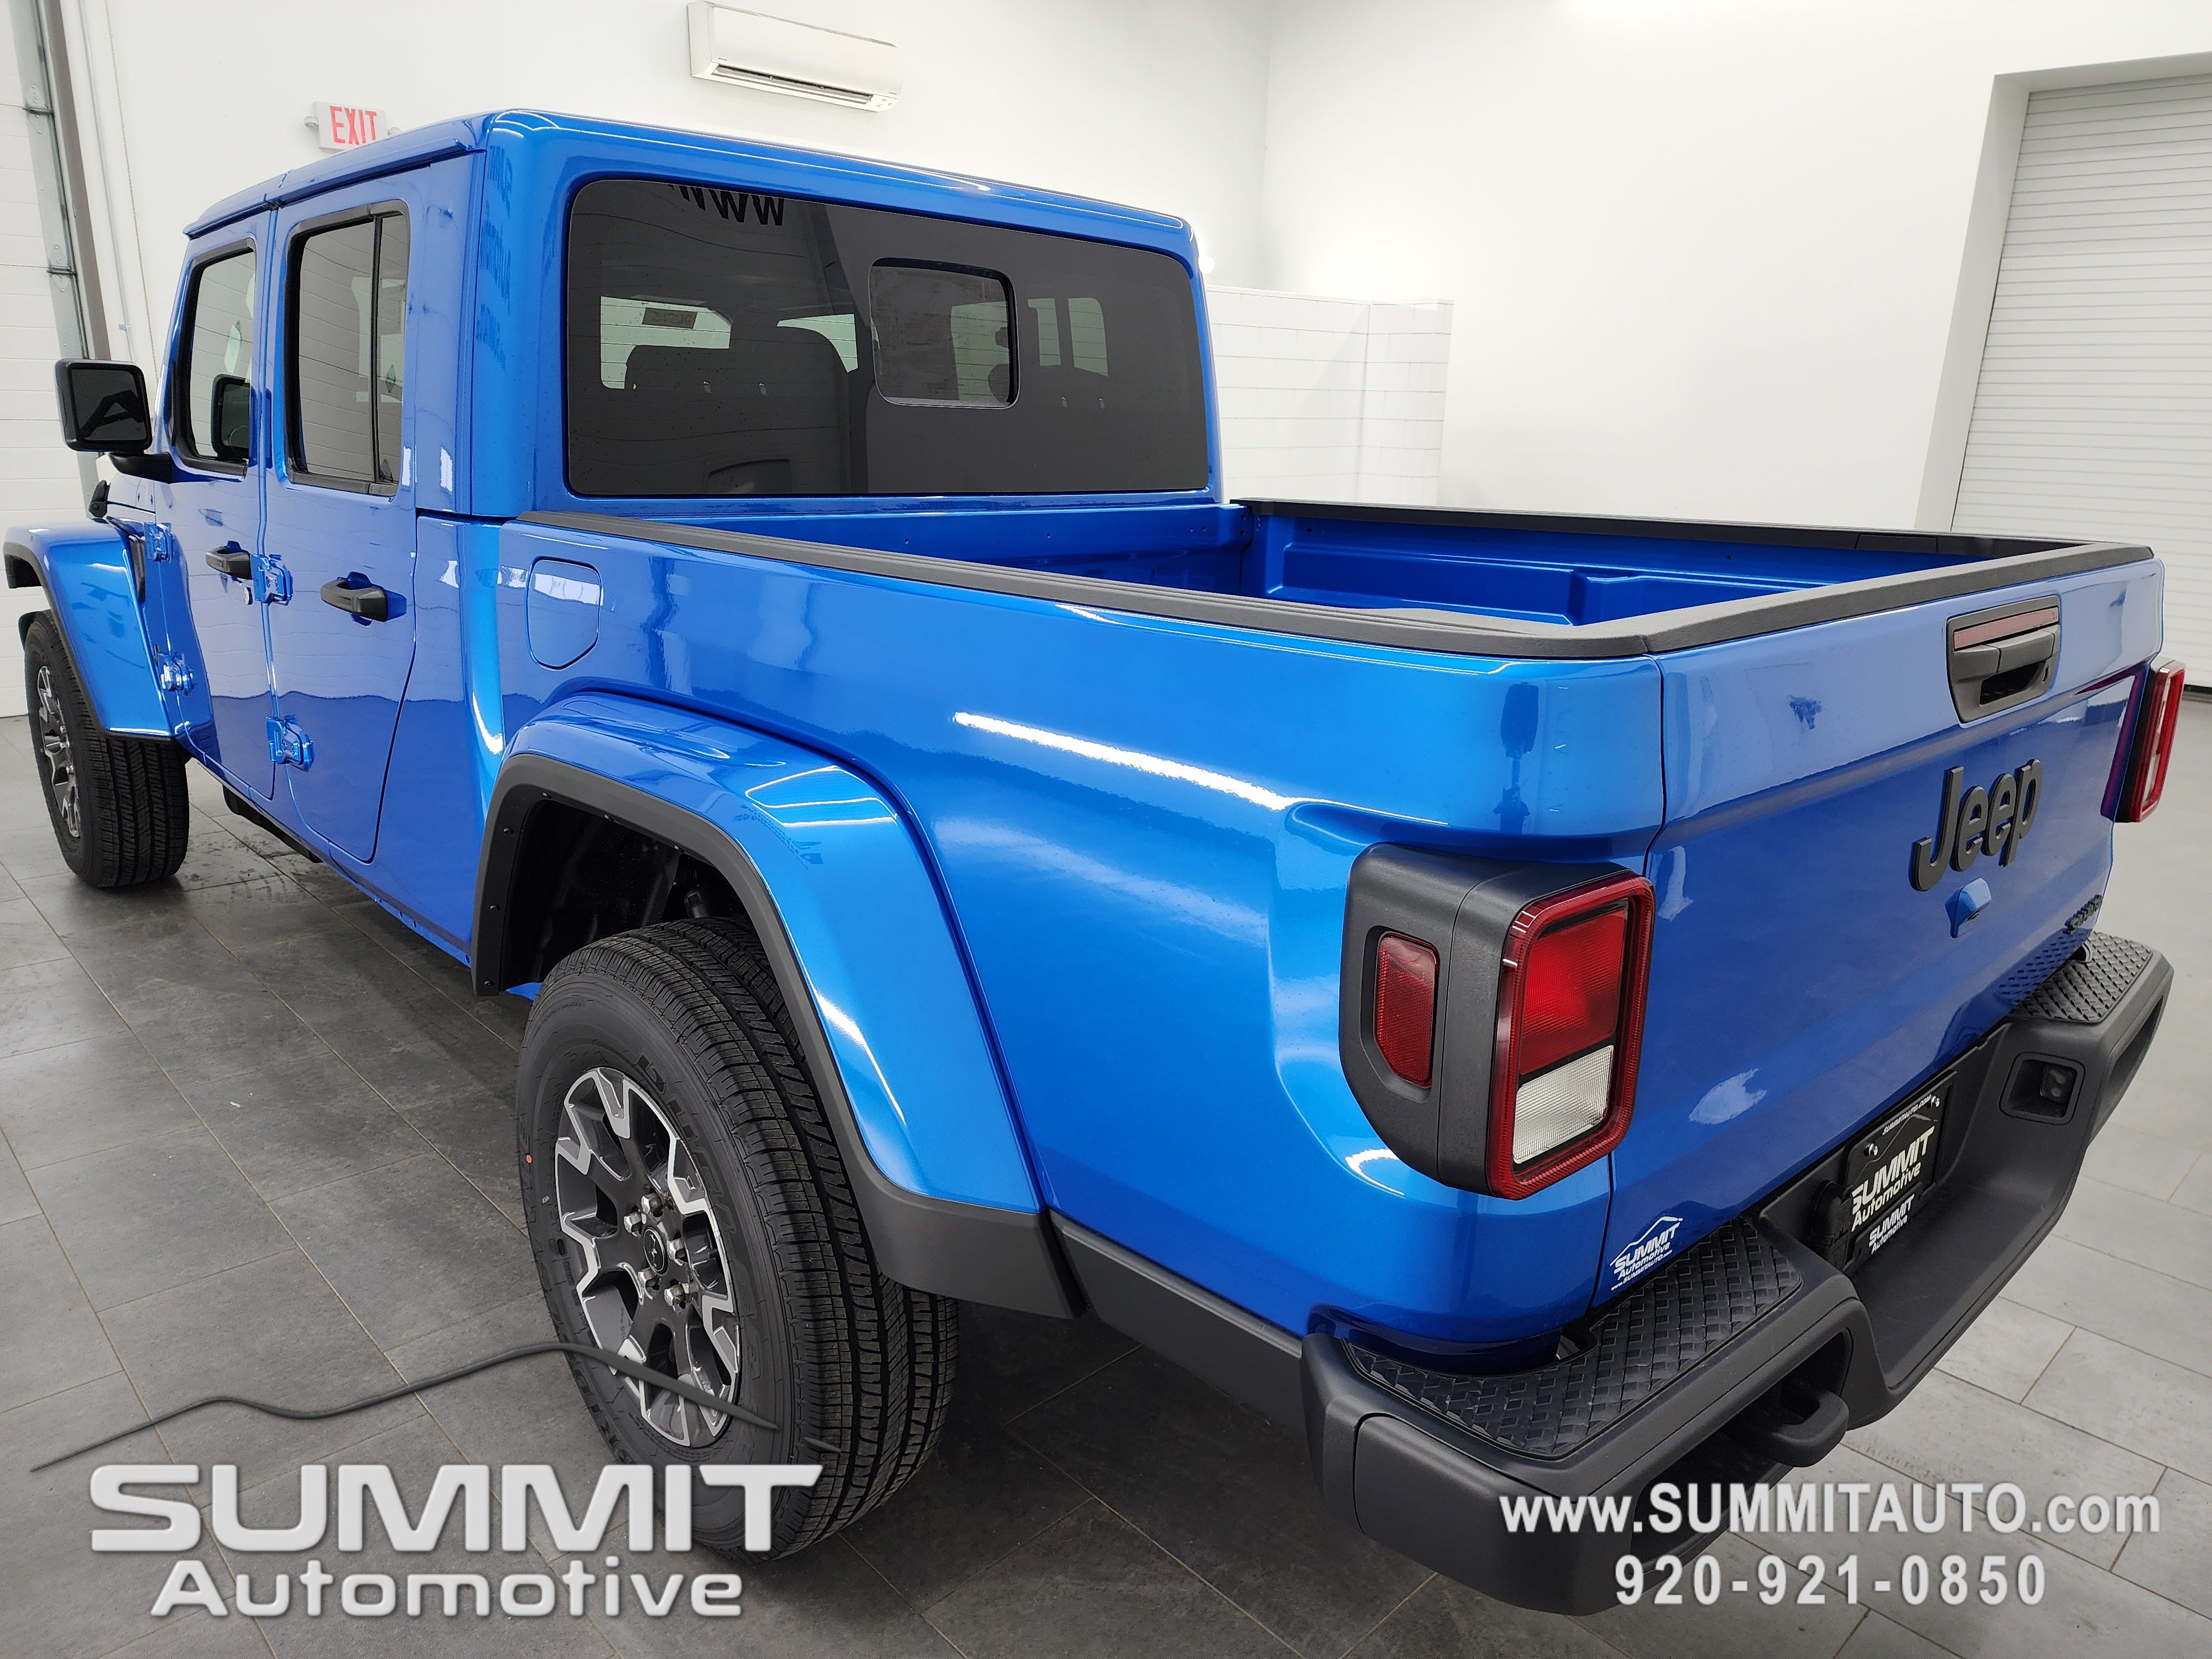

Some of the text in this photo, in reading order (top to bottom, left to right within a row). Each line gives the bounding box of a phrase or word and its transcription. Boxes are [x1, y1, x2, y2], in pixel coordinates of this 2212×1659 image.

[329, 105, 377, 145] EXIT
[1908, 759, 2043, 892] Jeep
[1852, 1125, 1934, 1215] SUMMIT
[1851, 1162, 1921, 1232] Automotive
[1869, 1193, 1914, 1248] SUMMIT
[1614, 1222, 1680, 1274] SUMMIT
[1618, 1242, 1670, 1280] Automotive
[1871, 1215, 1907, 1255] Automotive
